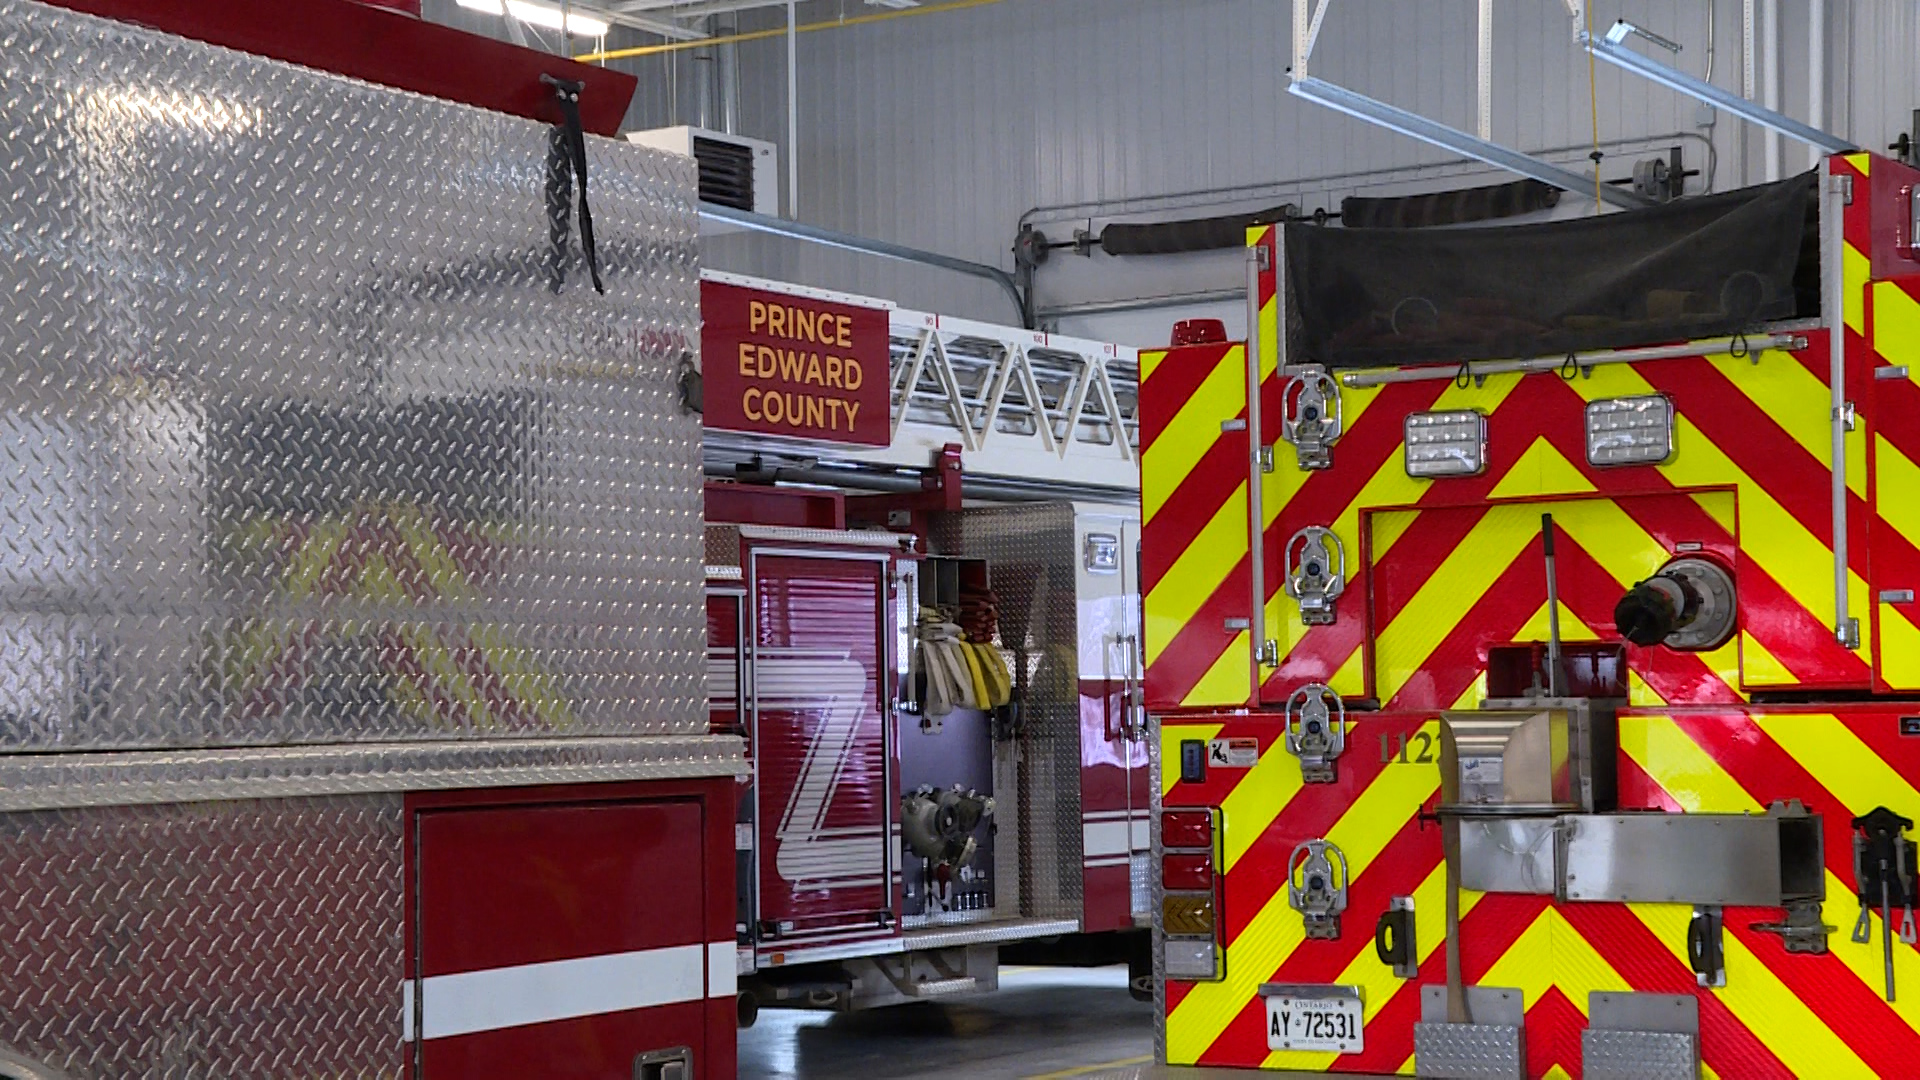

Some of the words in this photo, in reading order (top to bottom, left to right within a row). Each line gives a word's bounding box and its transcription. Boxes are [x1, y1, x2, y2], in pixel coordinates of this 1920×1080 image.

[749, 300, 853, 348] PRINCE
[739, 342, 863, 391] EDWARD
[742, 387, 860, 432] COUNTY
[1377, 731, 1441, 764] 112
[1294, 1001, 1333, 1009] ONTARIO
[1271, 1011, 1291, 1037] AY
[1302, 1011, 1356, 1040] 72531
